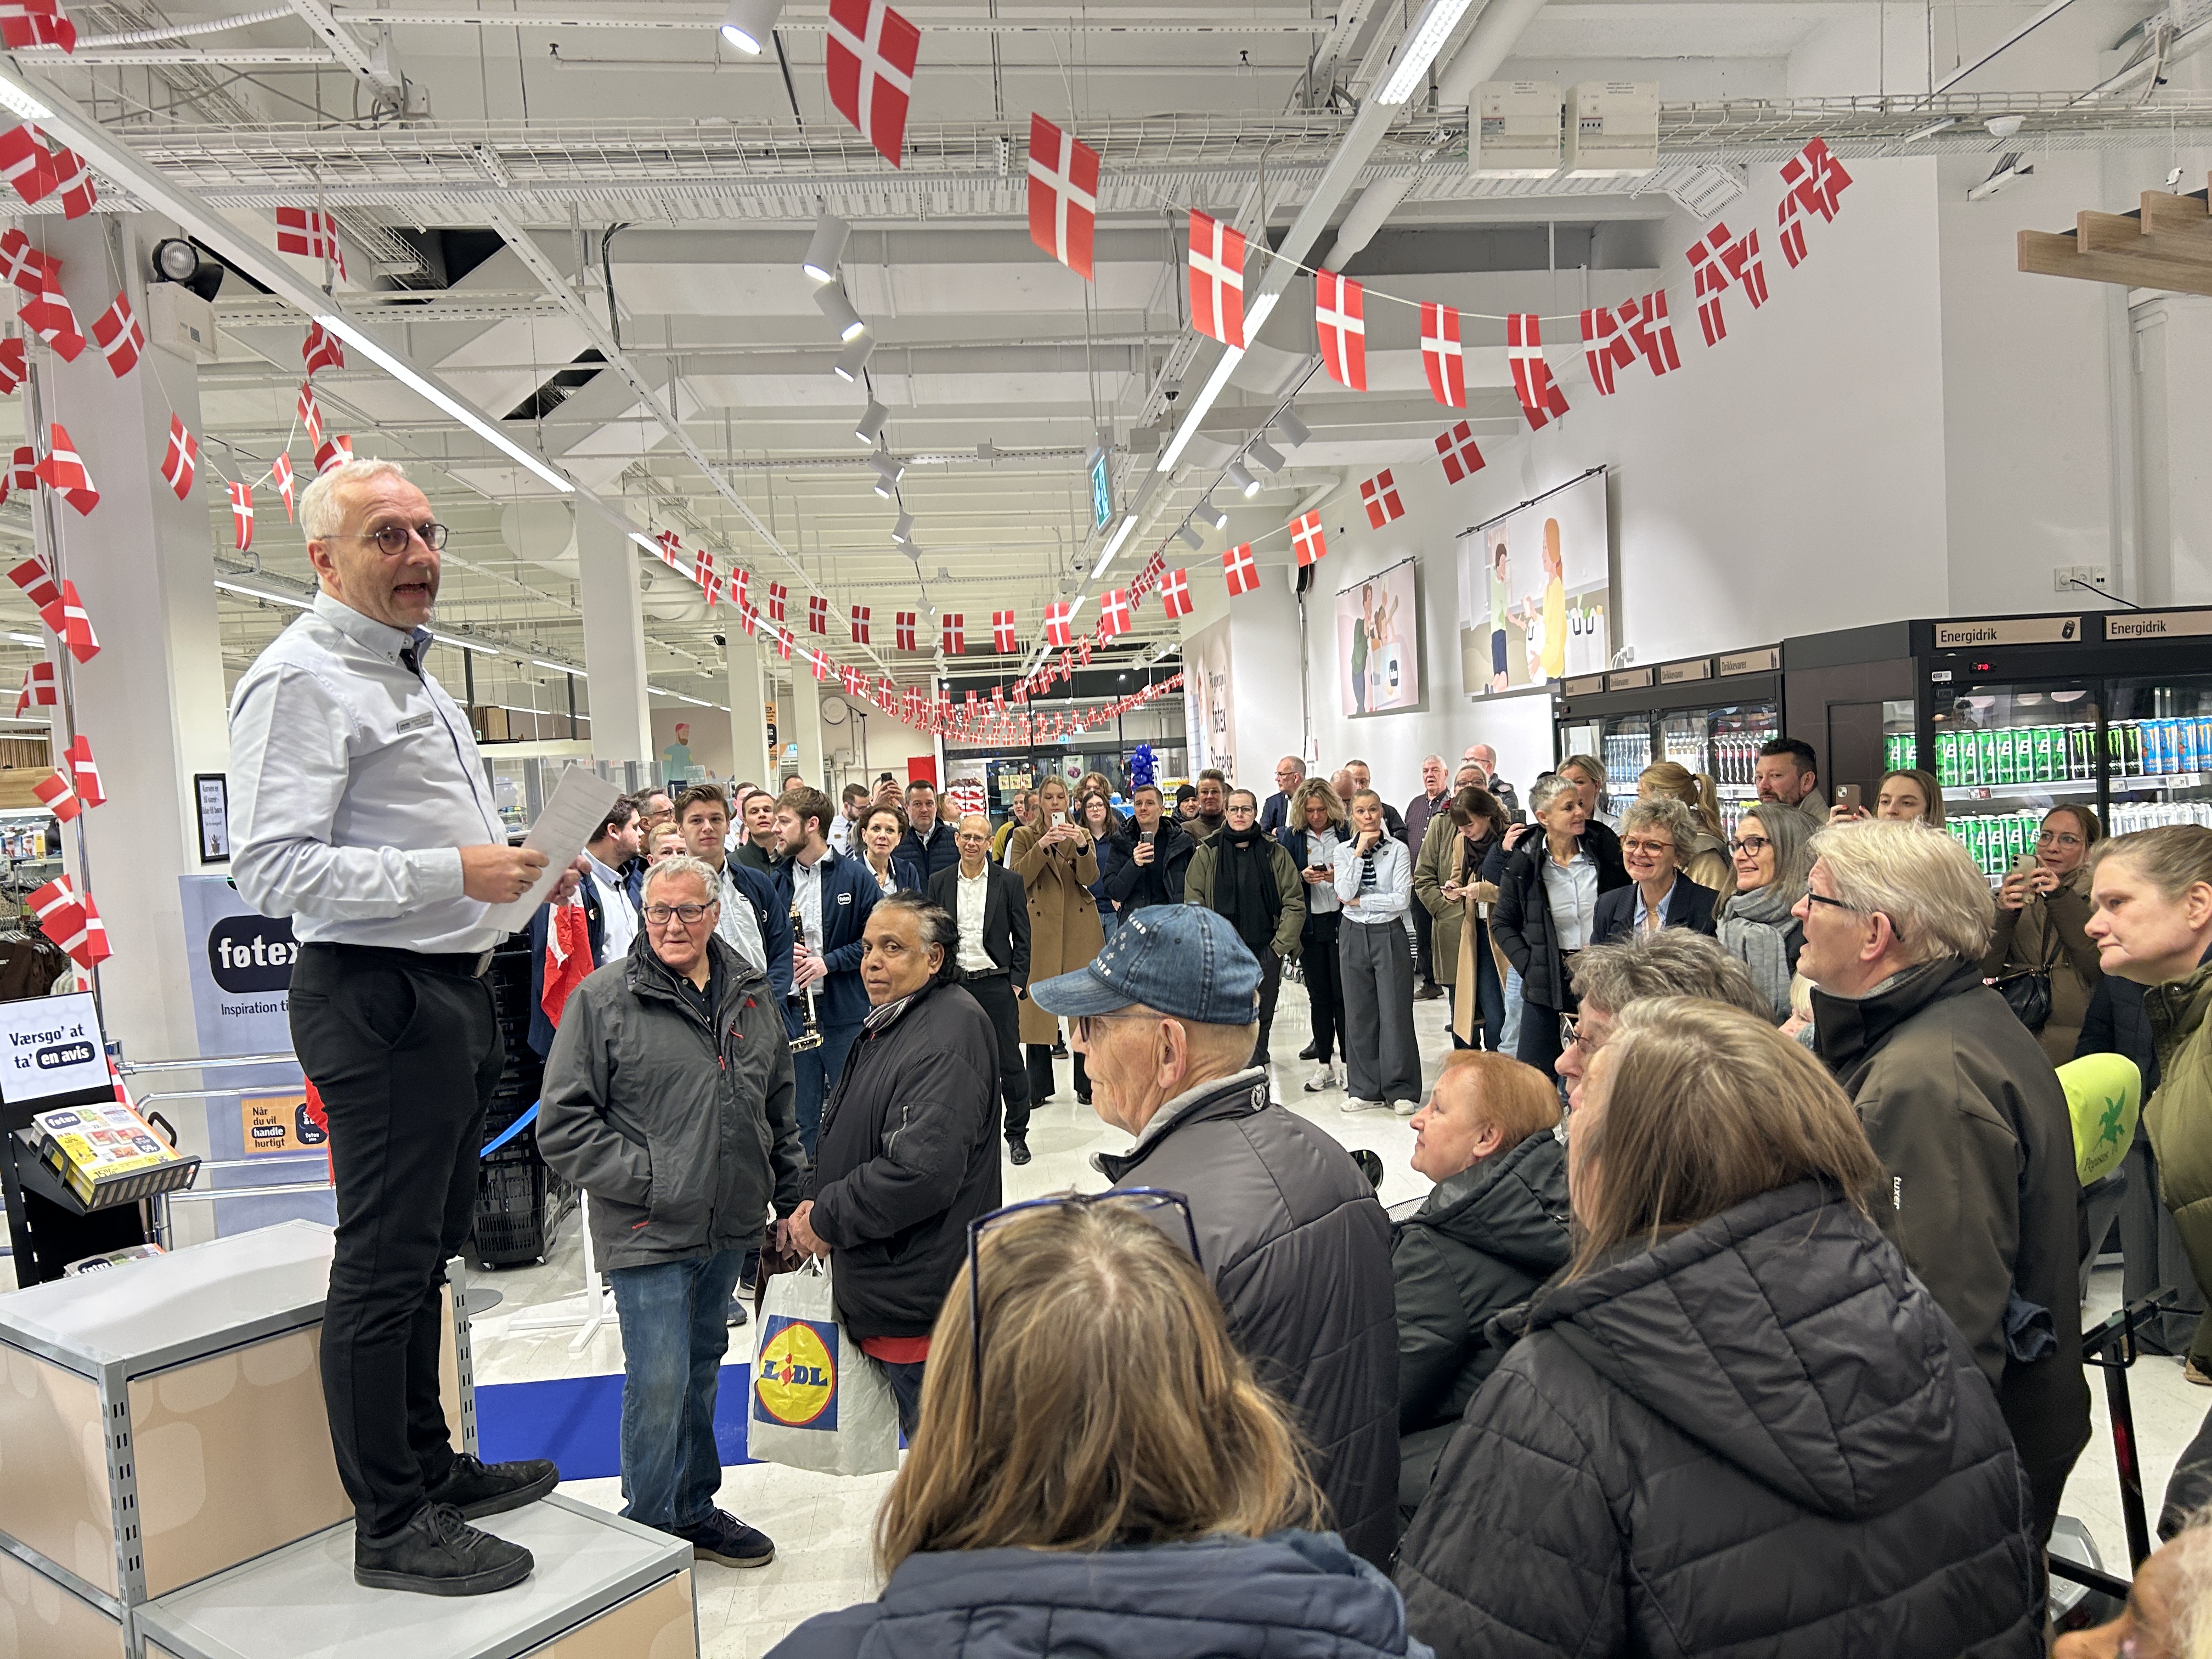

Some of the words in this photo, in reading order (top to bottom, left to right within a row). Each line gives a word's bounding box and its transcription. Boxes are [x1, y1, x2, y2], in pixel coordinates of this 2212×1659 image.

[2111, 620, 2166, 636] Energidrik
[1940, 628, 1997, 644] Energidrik
[1722, 661, 1747, 672] Drikkevarer
[1212, 700, 1227, 735] føtex
[218, 934, 304, 969] føtex
[221, 1002, 277, 1017] Inspiration
[280, 1000, 289, 1011] ti
[70, 1023, 84, 1037] at
[41, 1053, 59, 1065] en
[61, 1046, 89, 1062] avis
[252, 1107, 268, 1116] Når
[253, 1117, 264, 1125] du
[267, 1116, 276, 1125] vil
[253, 1127, 284, 1137] handle
[255, 1138, 285, 1148] hurtigt
